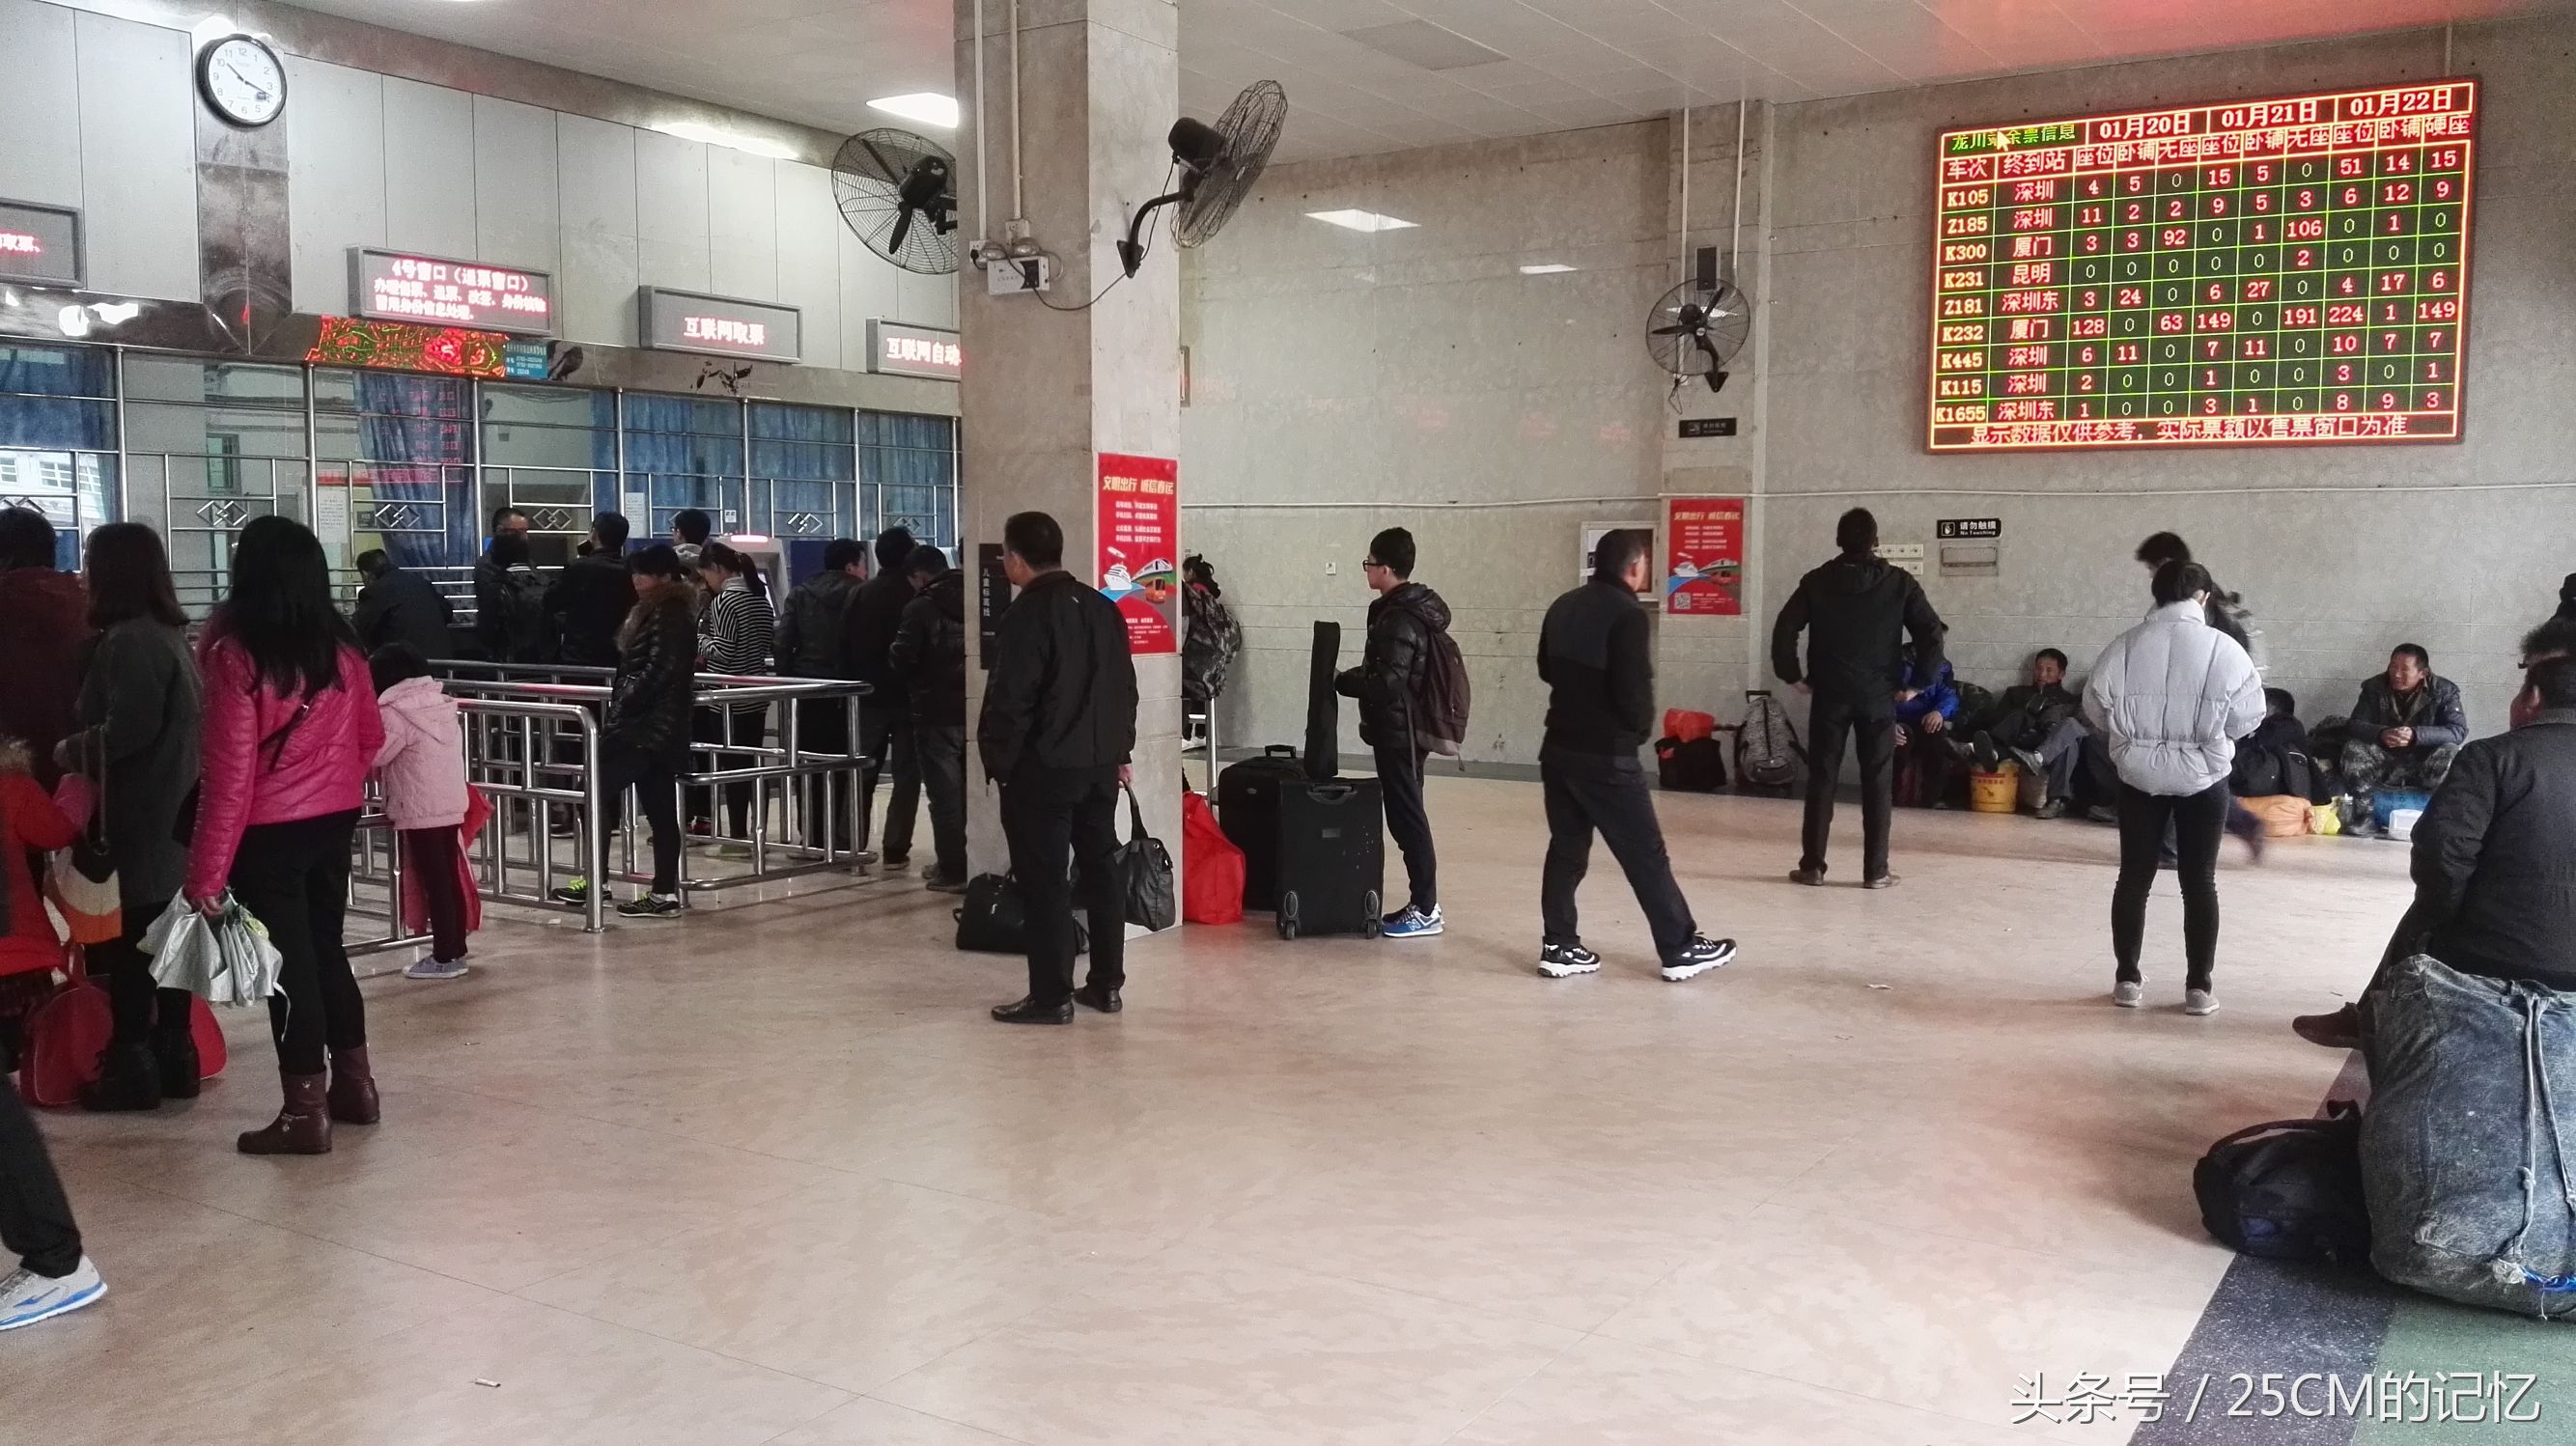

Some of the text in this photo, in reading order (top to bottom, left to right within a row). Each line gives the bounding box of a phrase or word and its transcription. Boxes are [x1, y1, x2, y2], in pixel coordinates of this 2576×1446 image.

[225, 49, 233, 58] 11
[238, 47, 247, 56] 12
[2100, 112, 2190, 139] 01月20日
[2222, 100, 2316, 127] 01月21日
[2350, 88, 2451, 115] 01月22日
[1947, 115, 2470, 180] 车次 终到站 座位 卧铺 无座 座位 卧铺 无座 座位 卧铺 硬座
[1947, 151, 2456, 207] K105 深圳 4 5 0 15 5 0 51 14 15
[1947, 181, 2449, 234] Z185 深圳 11 2 2 9 5 3 6 12 9
[1946, 212, 2446, 261] K300 厦门 3 3 92 0 1 106 0 1 0
[1944, 242, 2444, 289] K231 昆明 0 0 0 0 0 2 0 0 0
[1946, 272, 2444, 315] Z181 深圳东 3 24 0 6 27 0 4 17 6
[683, 317, 765, 346] 互联网取票
[1943, 302, 2456, 342] K232 厦门 128 0 63 149 0 191 224 1 149
[1942, 332, 2441, 369] K445 深圳 6 11 0 7 11 0 10 7 7
[1941, 363, 2438, 396] K115 深圳 2 0 0 1 0 0 3 0 1
[1936, 392, 2439, 422] K1655 深圳东 1 0 0 3 1 0 8 9 3
[1103, 476, 1175, 495] 文明出行 诚信春运
[1960, 521, 1997, 530] 请勿触摸
